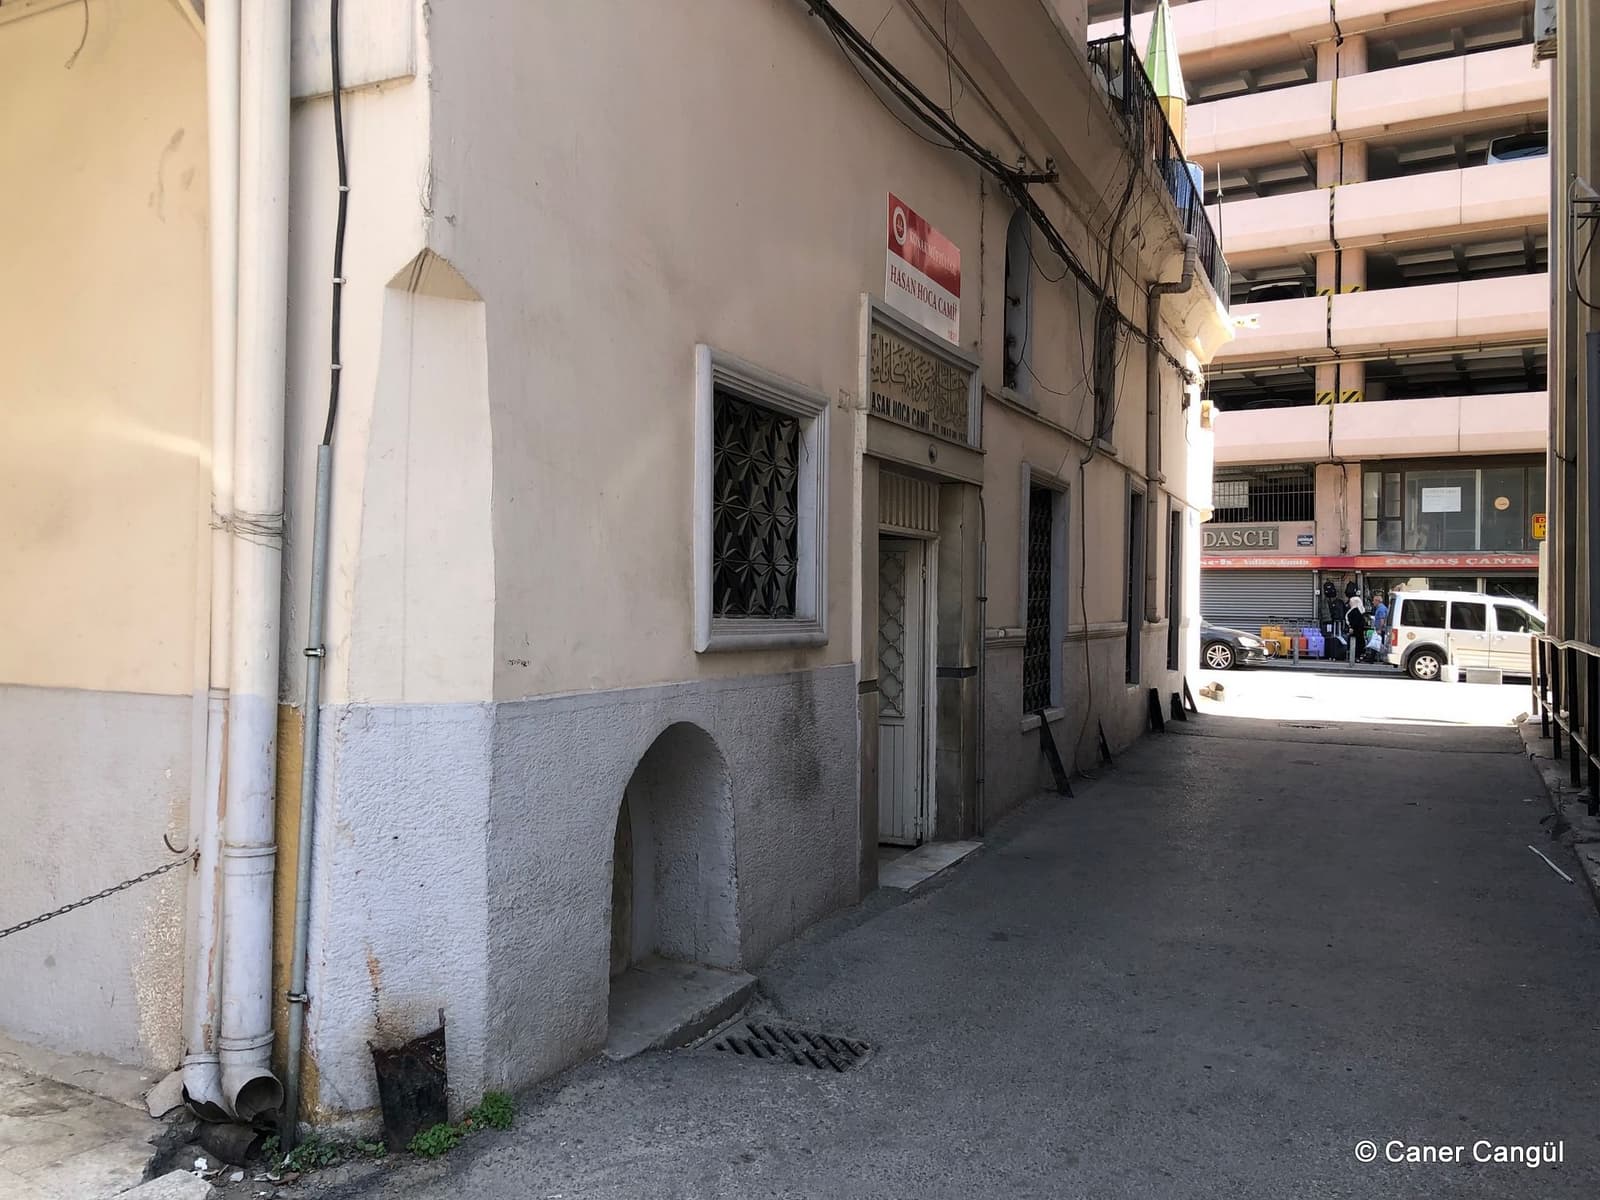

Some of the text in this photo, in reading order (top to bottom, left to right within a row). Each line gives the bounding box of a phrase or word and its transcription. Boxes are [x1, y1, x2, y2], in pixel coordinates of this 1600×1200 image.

[890, 264, 917, 296] HASAN
[917, 282, 938, 312] HOCA
[870, 390, 891, 417] ASAN
[892, 399, 911, 424] HOCA
[1202, 529, 1275, 548] DASCH
